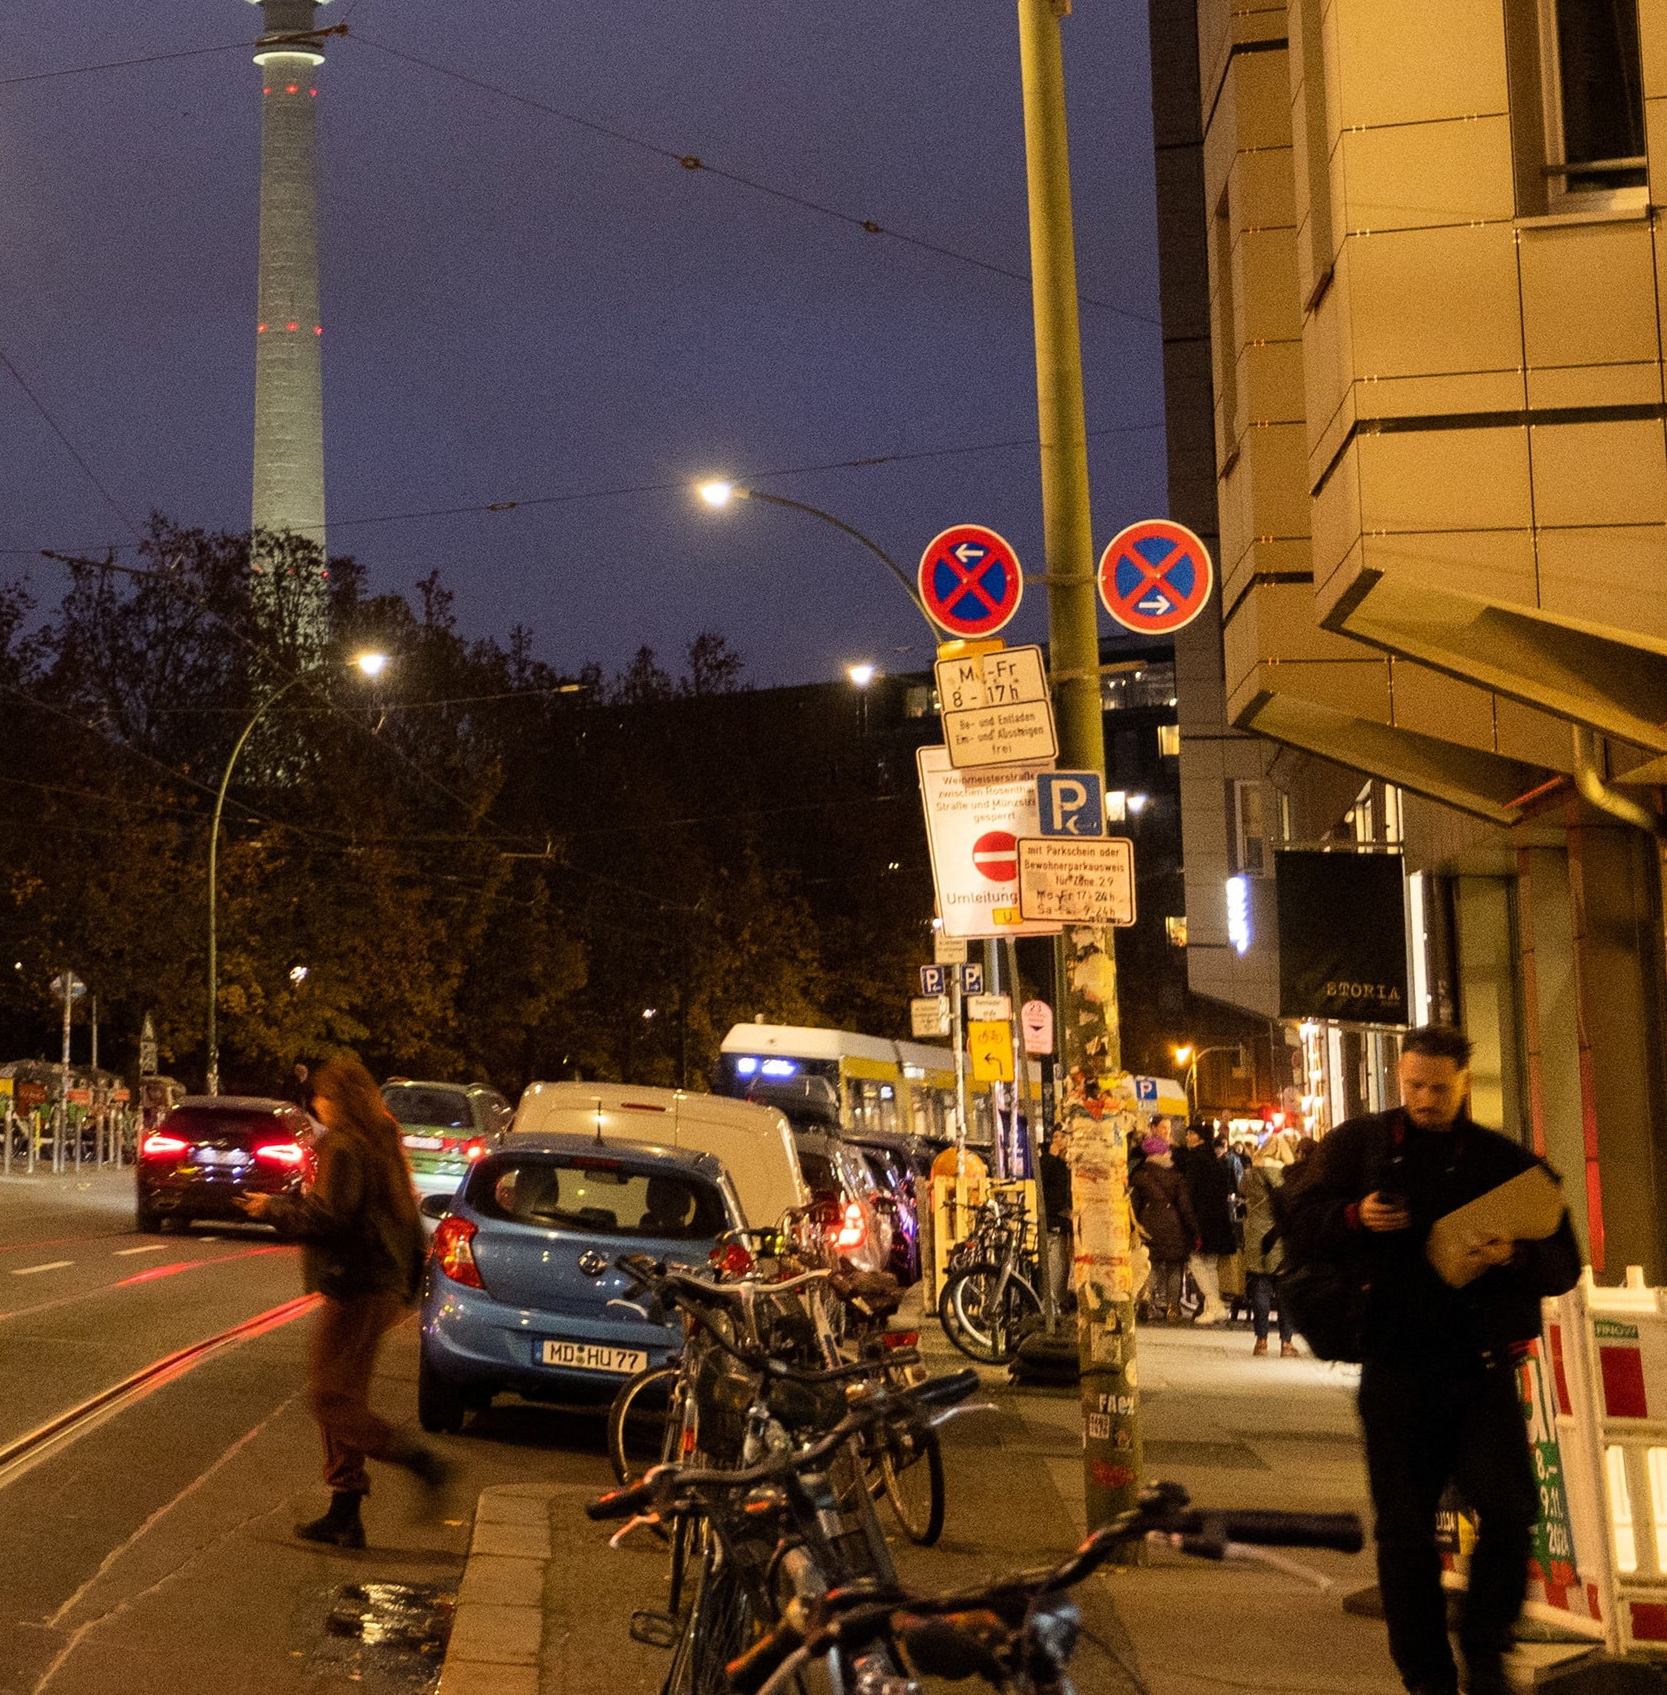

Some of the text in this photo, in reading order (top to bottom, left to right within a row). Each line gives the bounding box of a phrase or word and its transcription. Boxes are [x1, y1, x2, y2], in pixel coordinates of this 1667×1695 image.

[959, 660, 1016, 683] M-Fr
[952, 690, 963, 707] 8
[1027, 844, 1120, 857] mit Parkschein oder
[946, 891, 1018, 905] Umleitung
[550, 1343, 639, 1370] MD HU 77
